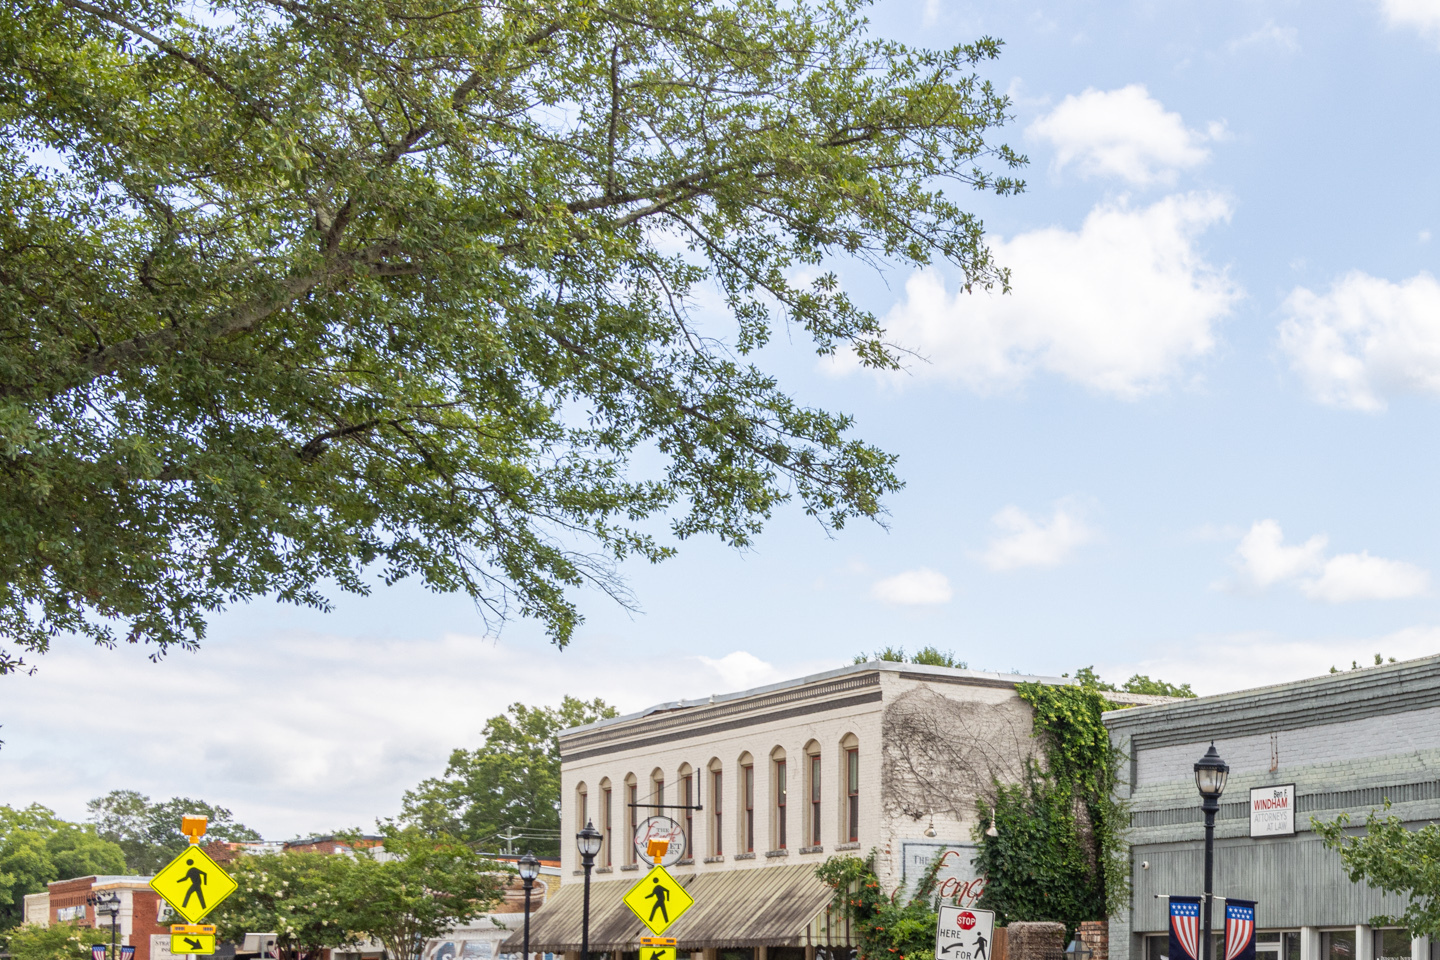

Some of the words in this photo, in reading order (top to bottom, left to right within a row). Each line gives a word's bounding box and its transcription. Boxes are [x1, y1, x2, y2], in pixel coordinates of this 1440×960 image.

[1254, 797, 1288, 810] WINDHAM
[1254, 811, 1288, 822] ATTORNEYS
[1266, 822, 1273, 831] AT
[1274, 821, 1288, 831] LAW
[914, 855, 930, 865] THE
[956, 917, 976, 925] STOP
[940, 928, 962, 939] HERE
[956, 951, 972, 960] FOR
